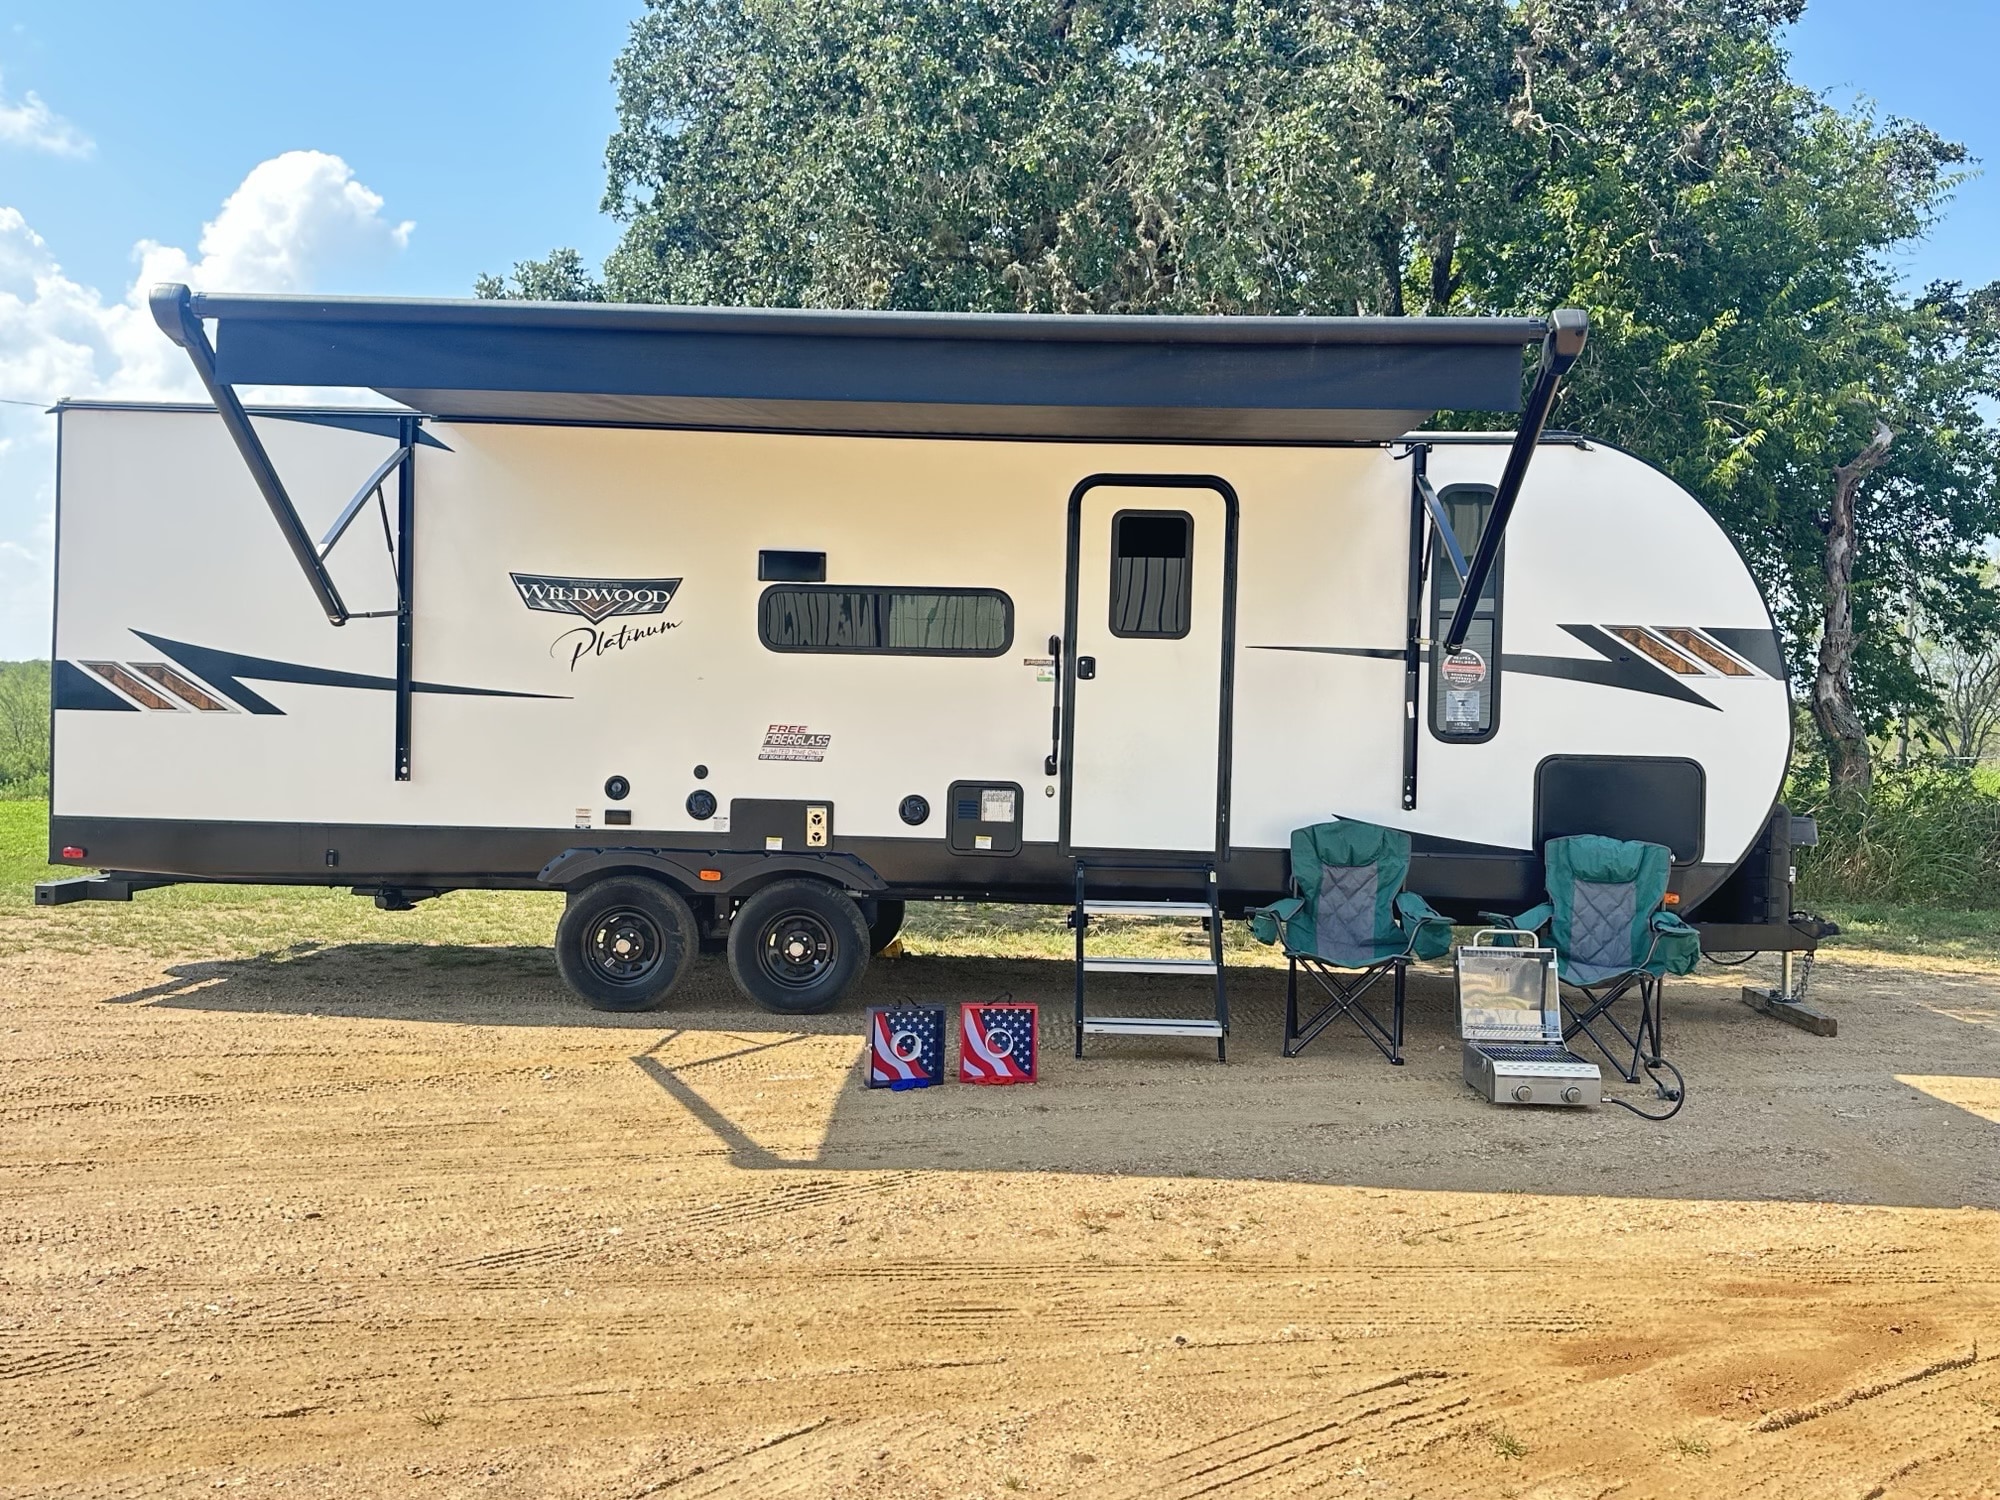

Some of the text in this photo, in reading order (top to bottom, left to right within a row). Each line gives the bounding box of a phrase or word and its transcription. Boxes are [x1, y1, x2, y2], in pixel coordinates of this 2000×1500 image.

[518, 583, 671, 603] WILDWOOD
[550, 620, 683, 672] Platinum
[768, 725, 808, 733] FREE
[764, 734, 830, 746] FIBERGLASS
